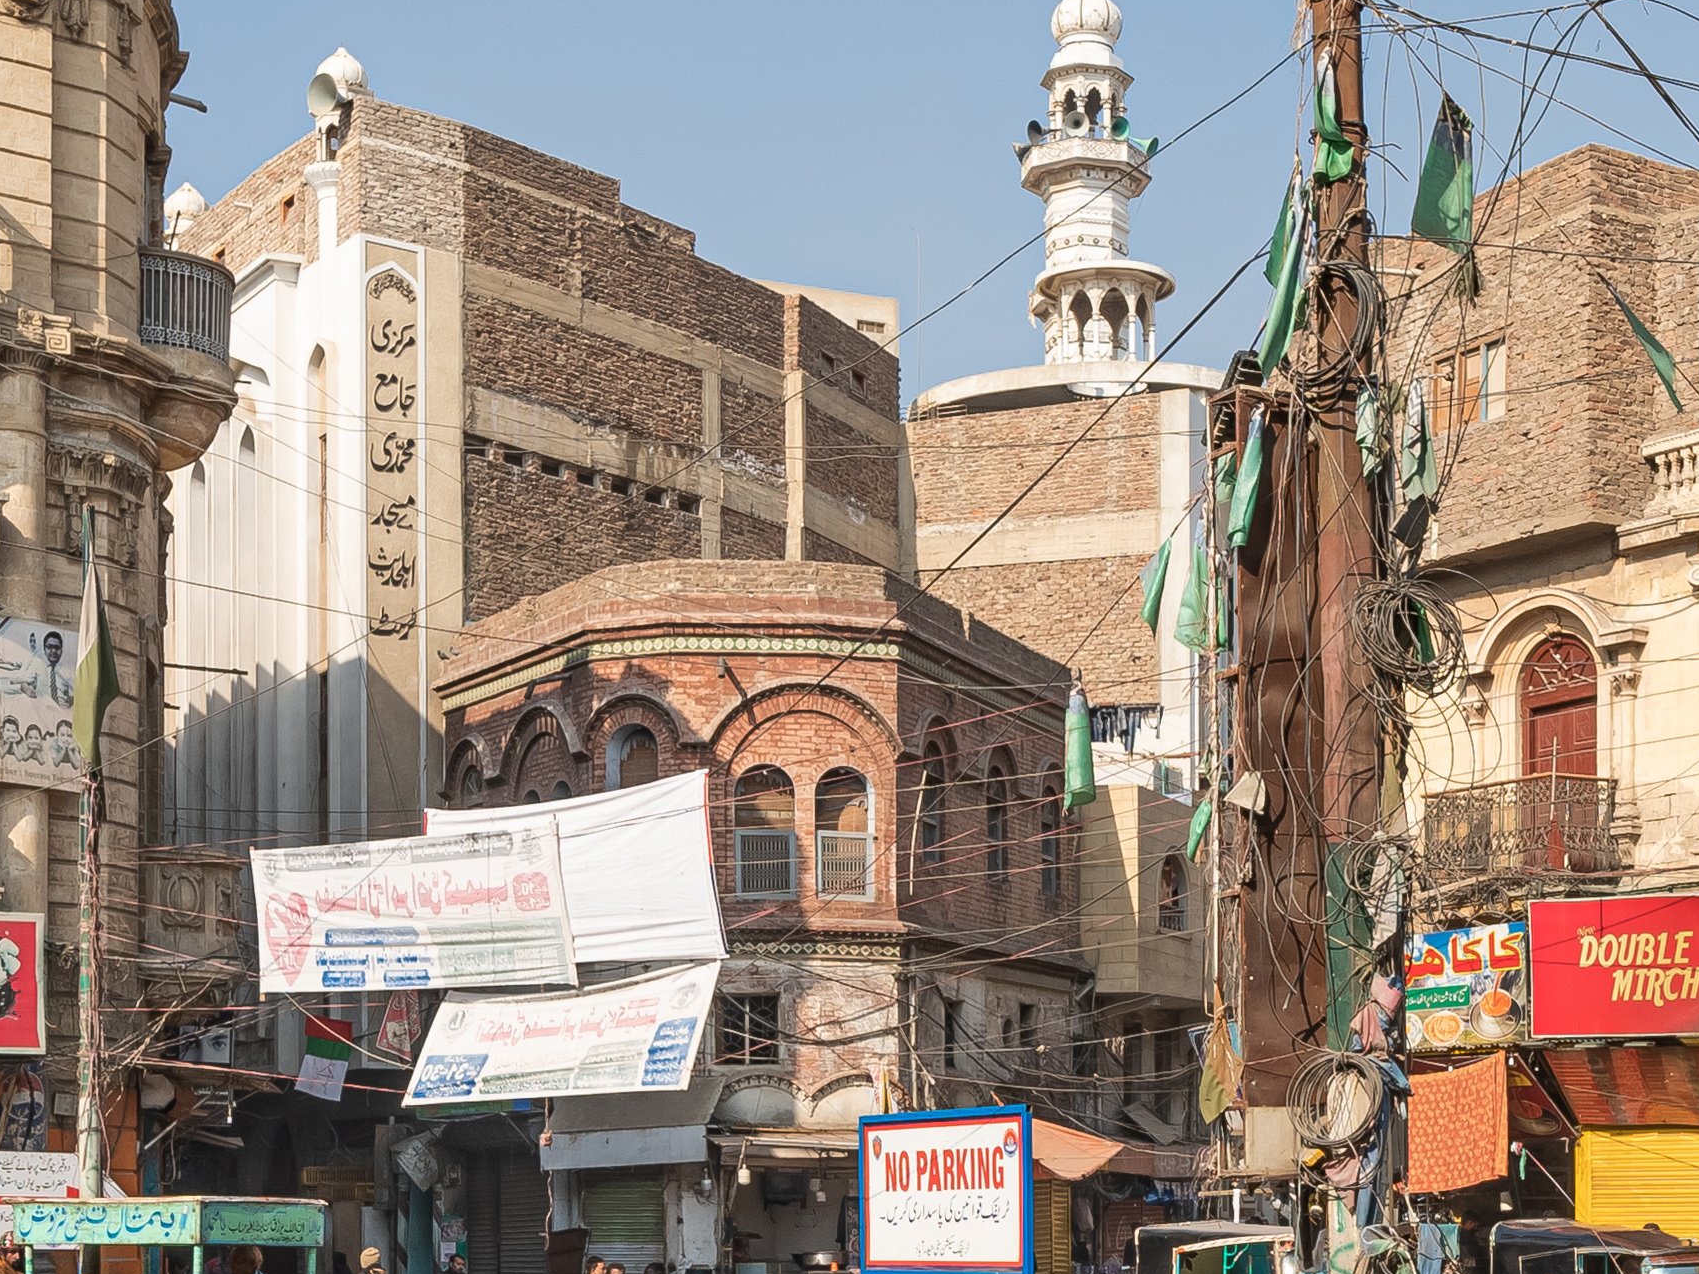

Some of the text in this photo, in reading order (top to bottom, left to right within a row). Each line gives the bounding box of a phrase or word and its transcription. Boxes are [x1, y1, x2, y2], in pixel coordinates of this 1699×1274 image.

[1578, 930, 1694, 968] DOUBLE
[885, 1146, 1004, 1192] NO PARKING
